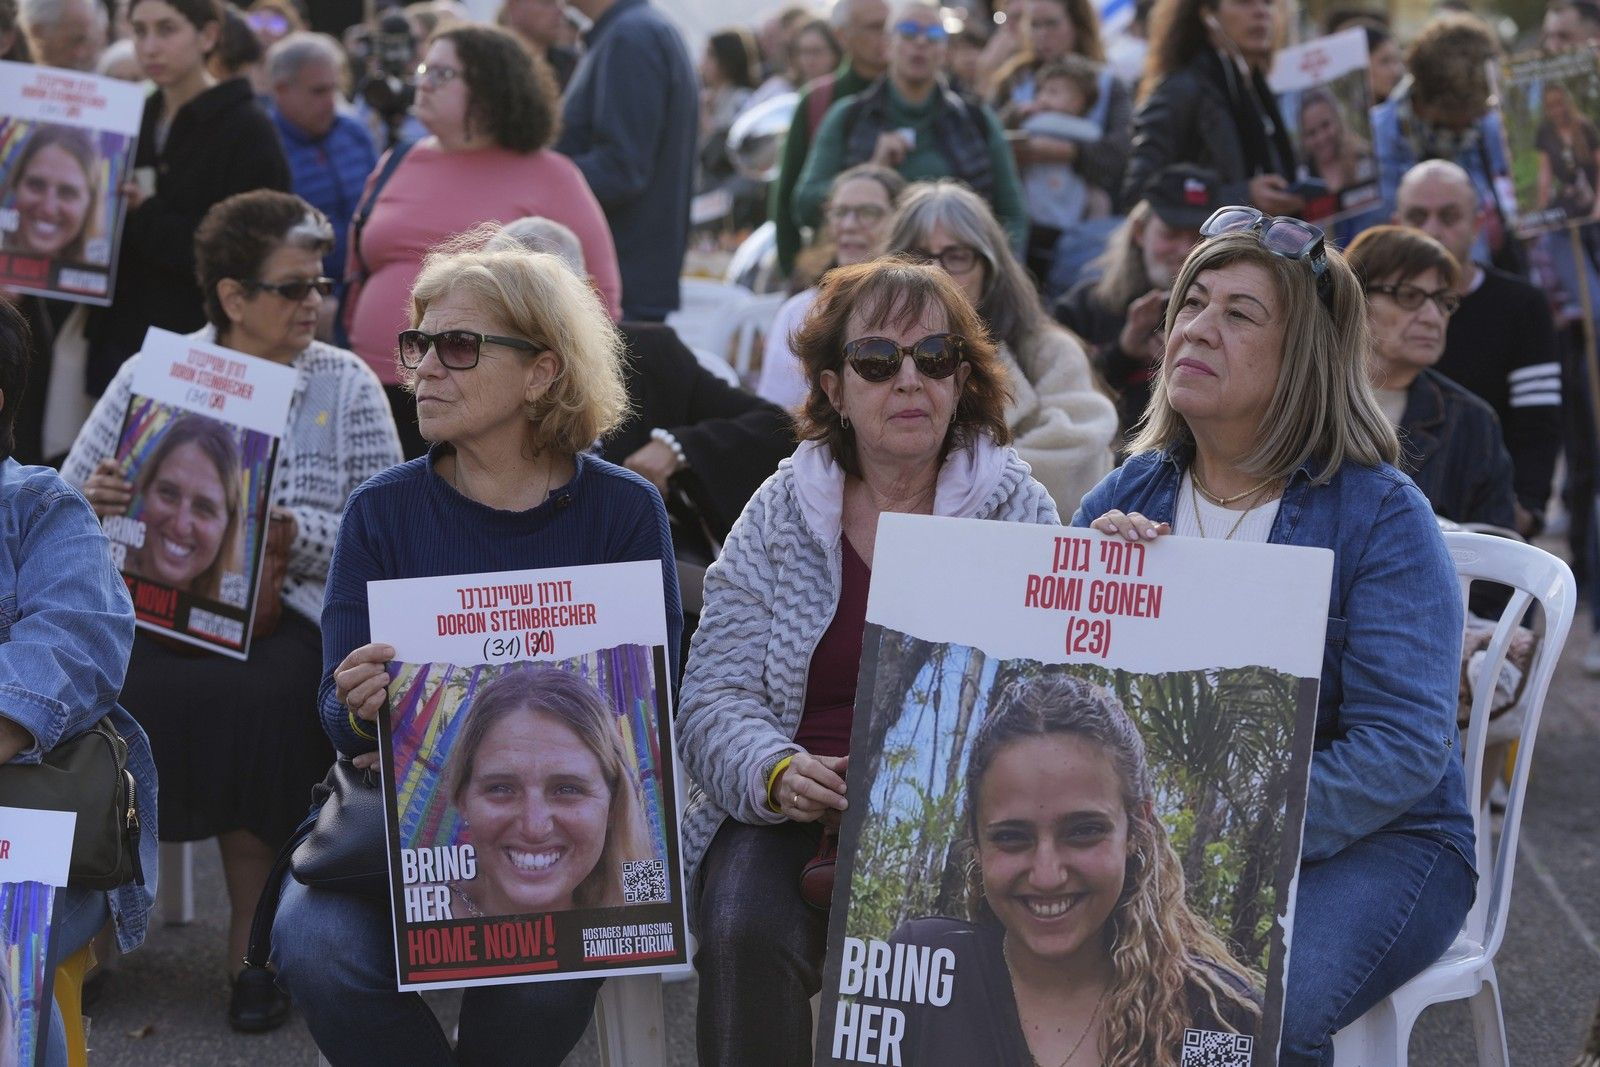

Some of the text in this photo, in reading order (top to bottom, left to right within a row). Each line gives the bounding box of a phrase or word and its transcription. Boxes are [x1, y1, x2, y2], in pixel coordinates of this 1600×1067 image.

[1052, 536, 1146, 577] רומי גונן
[457, 580, 572, 610] דורון שטיינברכר
[1024, 574, 1163, 619] ROMI GONEN
[437, 603, 597, 637] DORON STEINBRECHER
[1065, 616, 1112, 659] (23)
[483, 635, 521, 661] (31)
[401, 844, 477, 884] BRING
[404, 885, 453, 923] HER
[408, 915, 557, 966] HOME NOW!
[582, 922, 673, 940] HOSTAGES AND MISSING
[583, 935, 674, 958] FAMILIES FORUM
[838, 936, 956, 1007] BRING
[831, 1000, 906, 1067] HER
